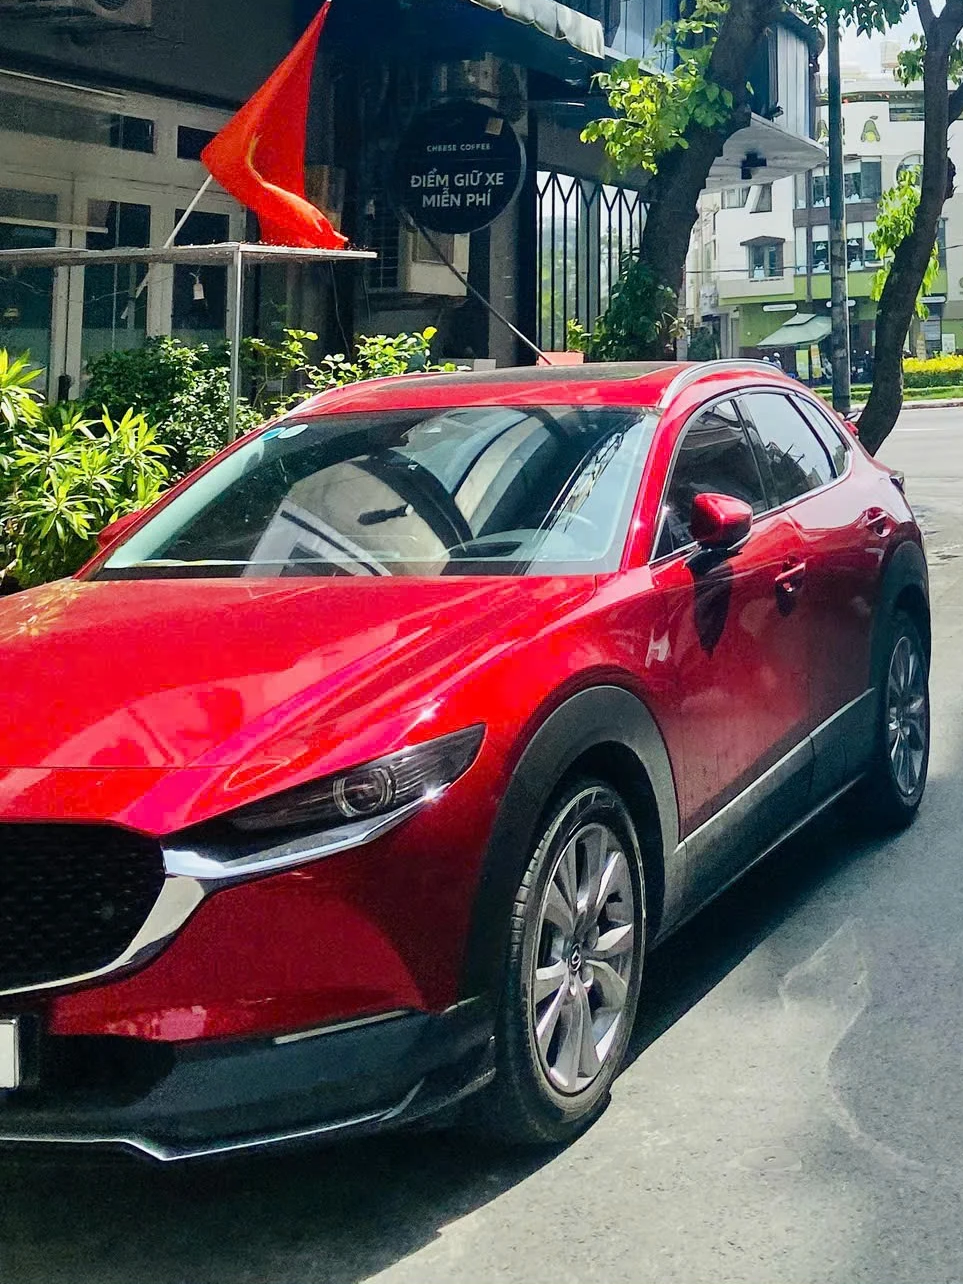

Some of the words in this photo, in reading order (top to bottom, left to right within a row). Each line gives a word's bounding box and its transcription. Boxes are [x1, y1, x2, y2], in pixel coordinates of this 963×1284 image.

[426, 144, 457, 153] CHEESE
[460, 143, 491, 151] COFFEE
[410, 168, 449, 188] ĐIỂM
[454, 170, 483, 187] GIỮ
[484, 172, 504, 186] XE
[422, 187, 461, 208] MIỄN
[466, 189, 491, 207] PHÍ
